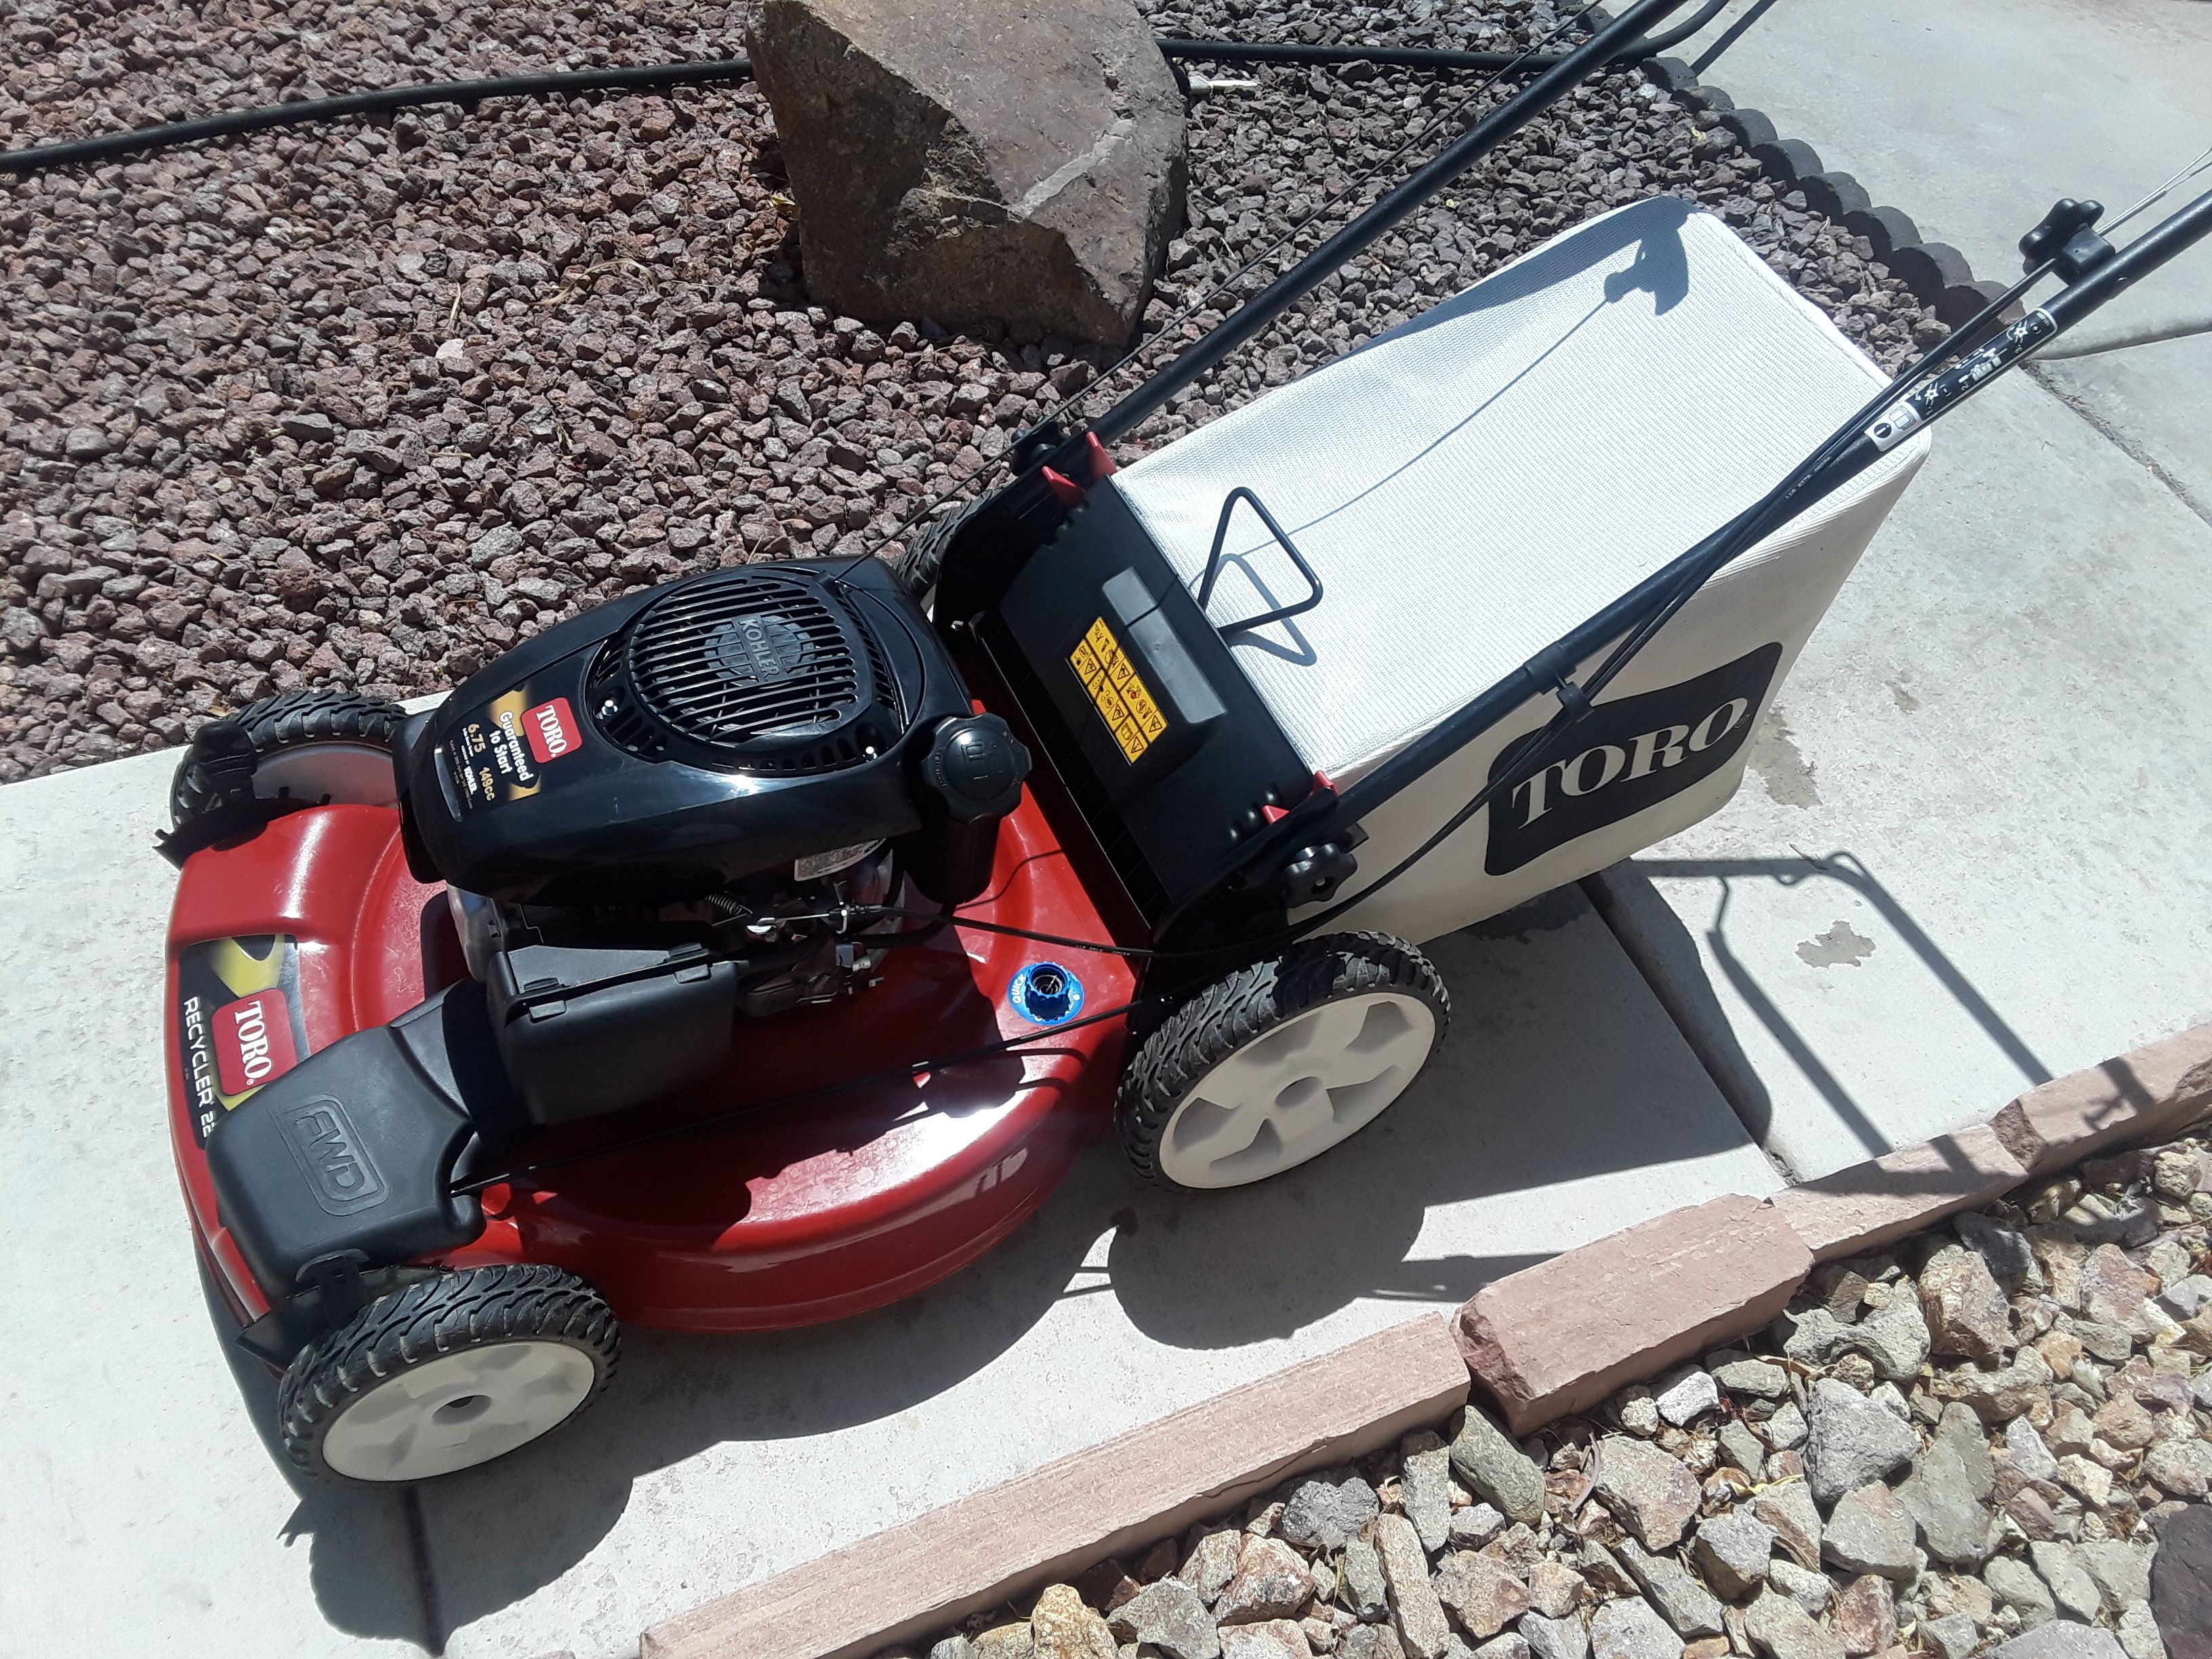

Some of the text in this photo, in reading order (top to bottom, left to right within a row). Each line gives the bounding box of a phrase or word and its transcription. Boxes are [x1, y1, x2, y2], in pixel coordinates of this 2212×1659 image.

[739, 617, 781, 679] KOHLER
[468, 724, 486, 753] 6.75
[479, 766, 495, 801] 149cc
[489, 730, 513, 774] to Start
[499, 711, 534, 781] Guaranteed
[536, 705, 568, 754] TORO
[1512, 697, 1748, 830] TORO
[1011, 973, 1026, 1004] QUICK
[184, 996, 213, 1106] RECYCLER
[234, 1000, 272, 1079] TORO
[295, 1111, 365, 1188] FWD
